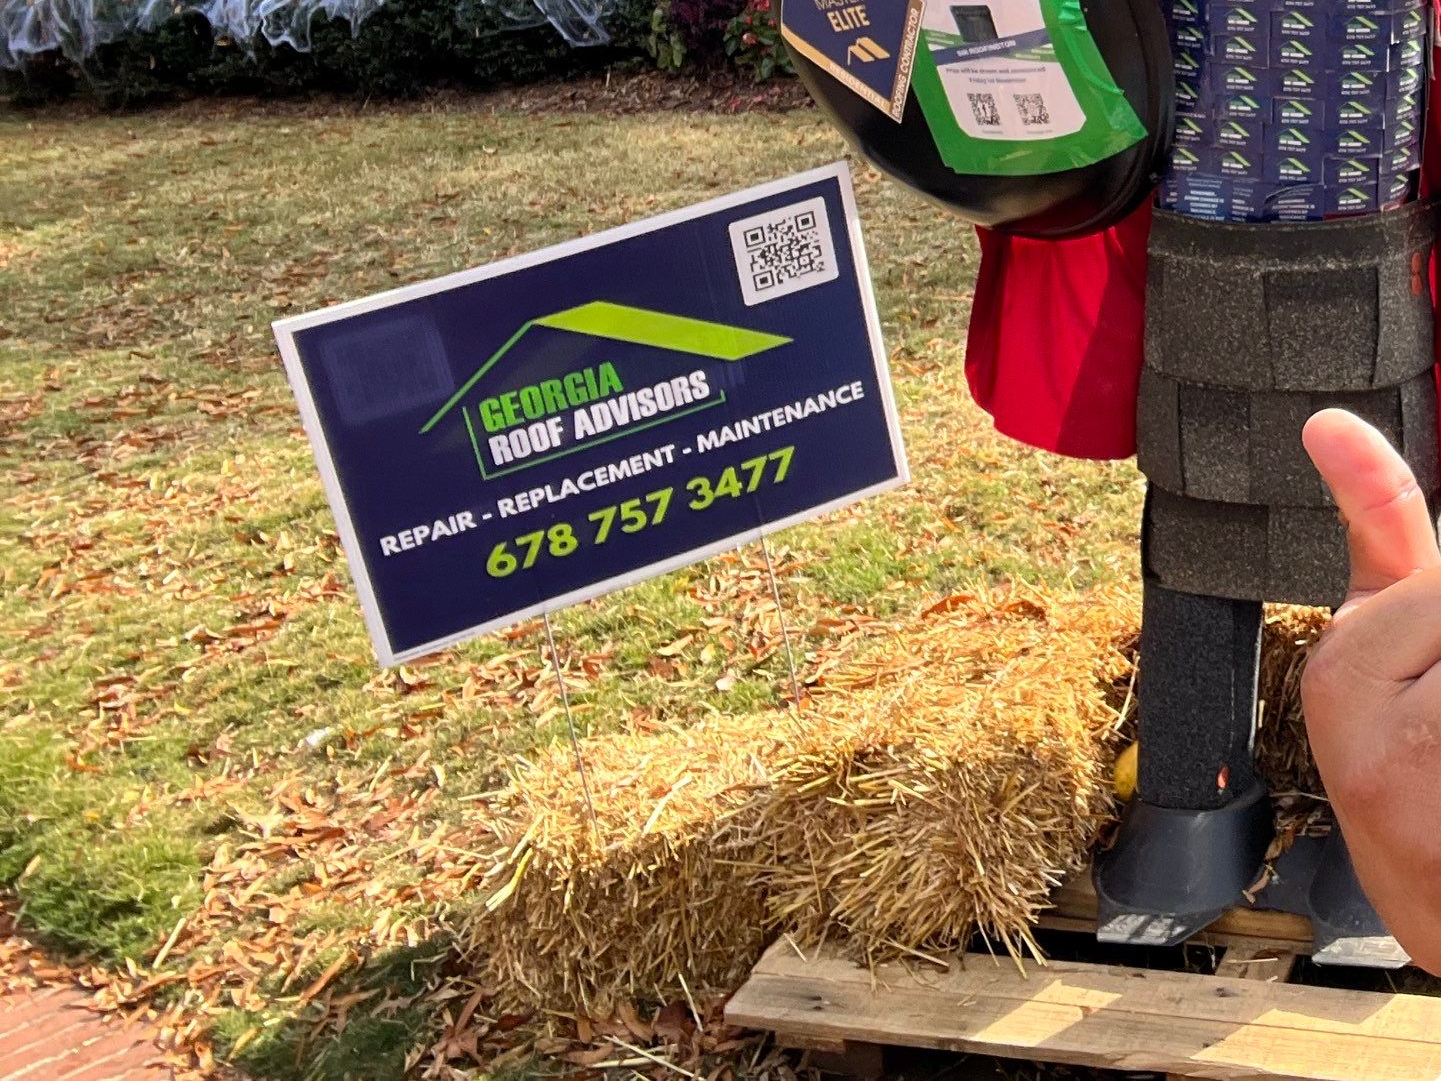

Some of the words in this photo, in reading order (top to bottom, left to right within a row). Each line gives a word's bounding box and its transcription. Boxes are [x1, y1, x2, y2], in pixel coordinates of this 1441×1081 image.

[827, 5, 871, 33] ELITE
[899, 8, 921, 73] CONTRACTOR
[891, 76, 909, 118] ROOFING
[479, 361, 624, 435] GEORGIA
[488, 415, 564, 467] ROOF
[573, 370, 711, 441] ADVISORS
[379, 509, 477, 557] REPAIR
[497, 443, 677, 521] REPLACEMENT
[696, 380, 866, 455] MAINTENANCE
[485, 523, 580, 580] 678
[588, 488, 675, 546] 757
[685, 445, 797, 512] 3477
